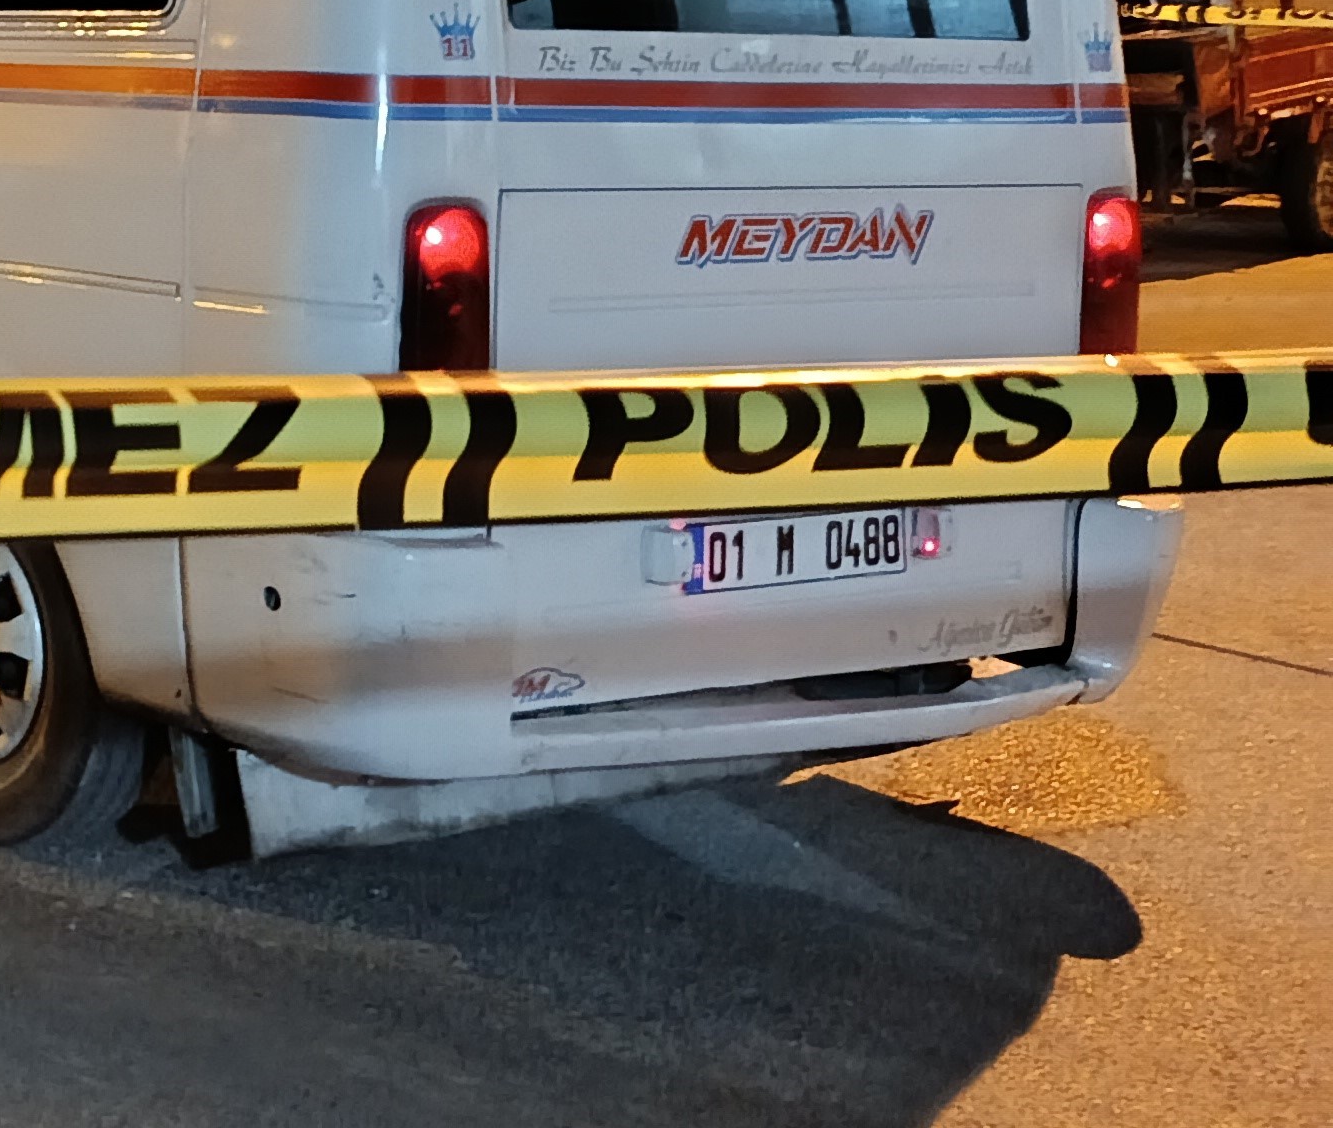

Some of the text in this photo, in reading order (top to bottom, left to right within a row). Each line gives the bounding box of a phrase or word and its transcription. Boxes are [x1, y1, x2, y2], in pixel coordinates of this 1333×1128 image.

[539, 46, 576, 72] Biz
[590, 46, 622, 72] Bu
[677, 203, 933, 268] MEYDAN
[708, 514, 901, 583] 01 M 0488
